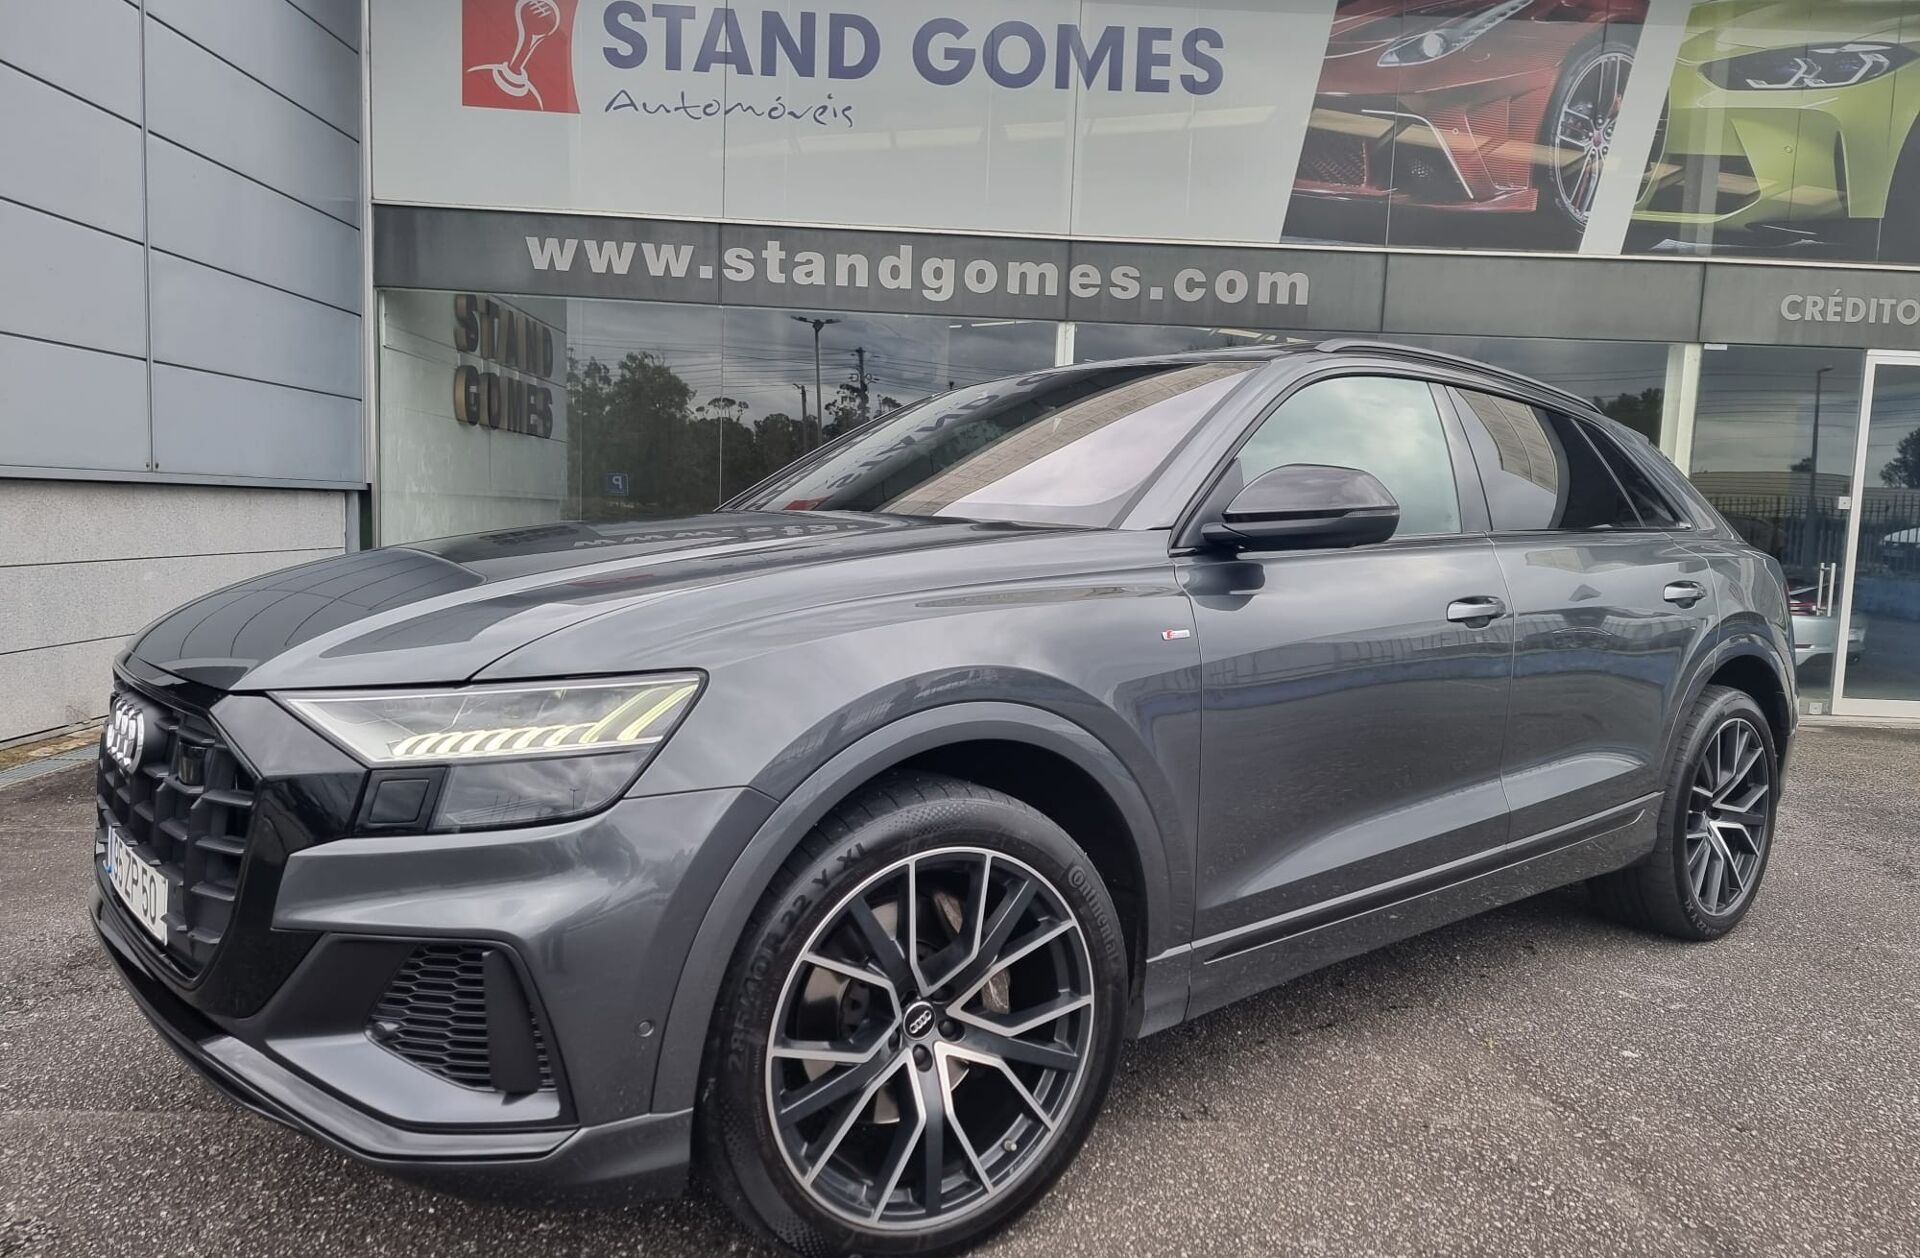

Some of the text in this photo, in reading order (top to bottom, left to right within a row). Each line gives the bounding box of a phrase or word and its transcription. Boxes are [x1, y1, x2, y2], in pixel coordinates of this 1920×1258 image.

[602, 0, 1225, 96] STAND GOMES
[604, 89, 854, 128] Automóveis
[525, 236, 1310, 306] www.standgomes.com
[1781, 289, 1920, 325] CRÉDITO
